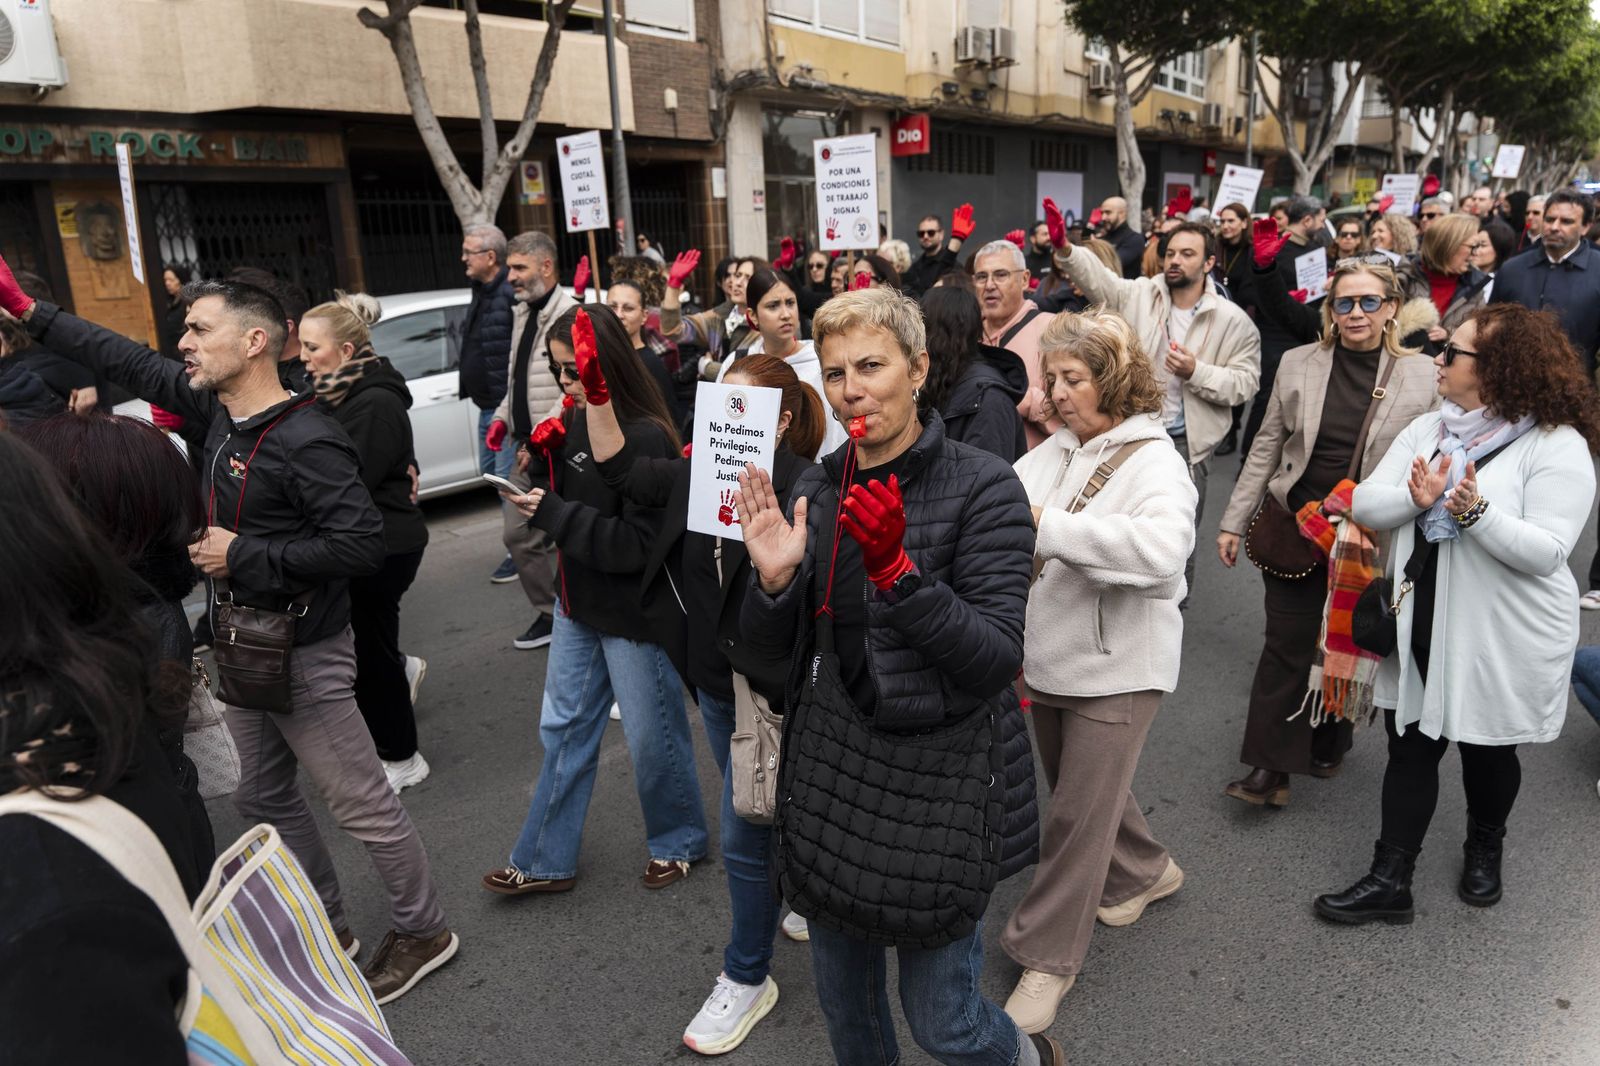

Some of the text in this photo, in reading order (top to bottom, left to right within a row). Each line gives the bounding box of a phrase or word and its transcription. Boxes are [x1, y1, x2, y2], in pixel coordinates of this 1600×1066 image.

[89, 130, 205, 160] ROCK
[232, 136, 308, 161] BAR
[570, 157, 591, 167] MENOS
[829, 167, 861, 176] POR UNA
[821, 179, 870, 190] CONDICIONES
[826, 192, 869, 203] DE TRABAJO
[833, 206, 860, 215] DIGNAS
[709, 421, 764, 438] No Pedimos
[709, 437, 761, 455] Privilegios,
[714, 453, 754, 468] Pedimo
